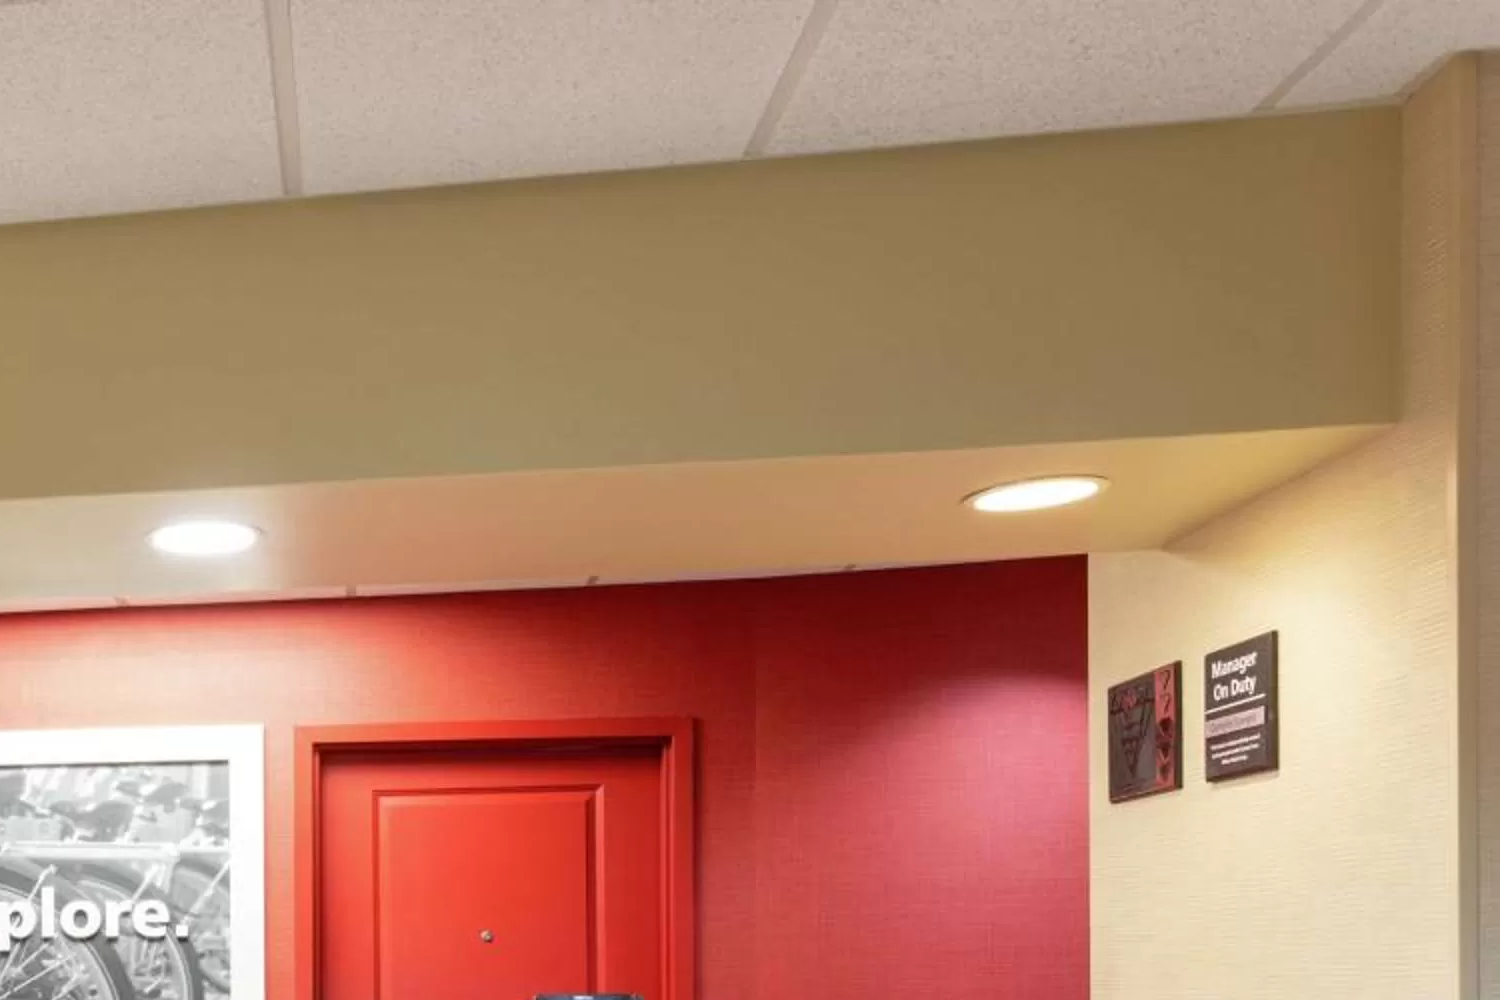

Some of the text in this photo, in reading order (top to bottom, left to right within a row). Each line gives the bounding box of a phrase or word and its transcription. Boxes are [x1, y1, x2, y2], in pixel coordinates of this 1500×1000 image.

[1211, 652, 1258, 679] Manager
[1213, 676, 1257, 701] On Duty
